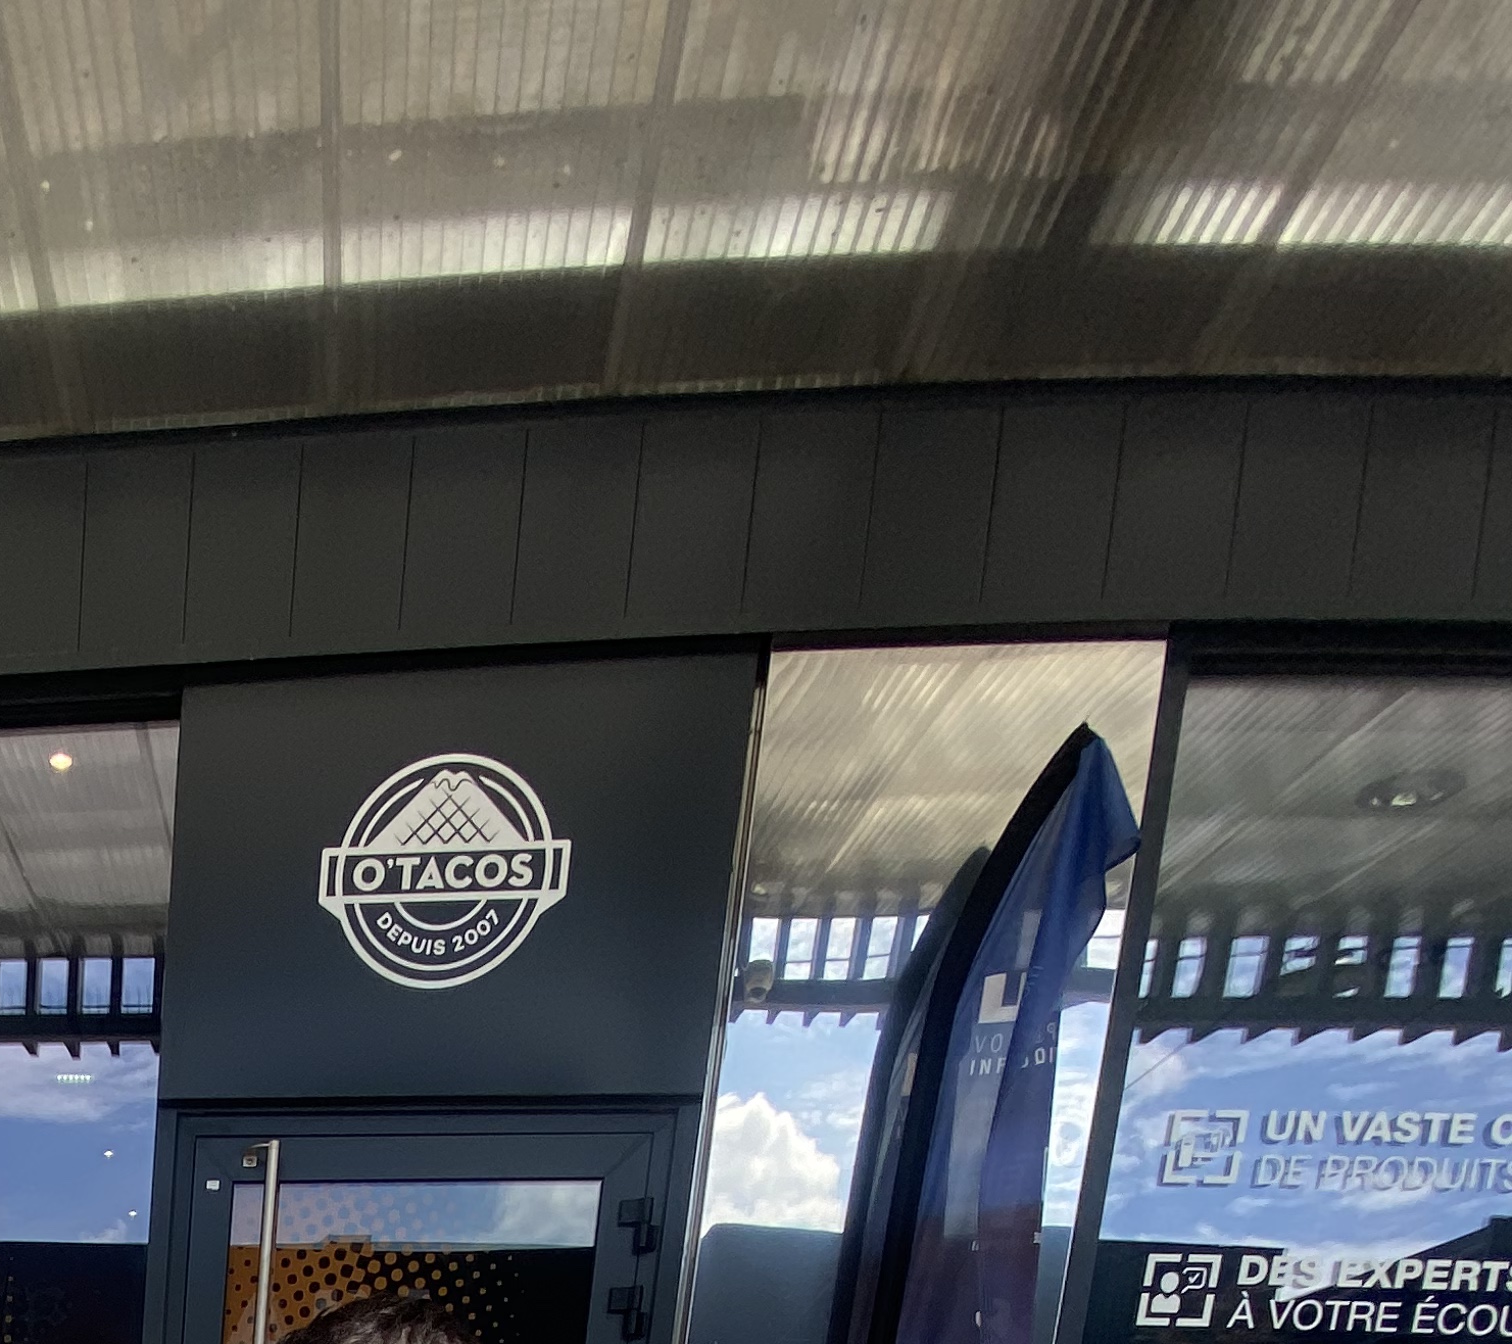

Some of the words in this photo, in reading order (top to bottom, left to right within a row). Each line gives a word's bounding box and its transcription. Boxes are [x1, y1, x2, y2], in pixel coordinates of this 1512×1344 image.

[352, 852, 534, 892] O'TACOS
[376, 911, 447, 956] DEPUIS
[451, 908, 501, 953] 2007
[1265, 1110, 1327, 1143] UN
[1341, 1110, 1478, 1145] VASTE
[1257, 1154, 1313, 1187] DE
[1237, 1254, 1324, 1290] DES
[1226, 1291, 1255, 1330] À
[1269, 1298, 1403, 1333] VOTRE
